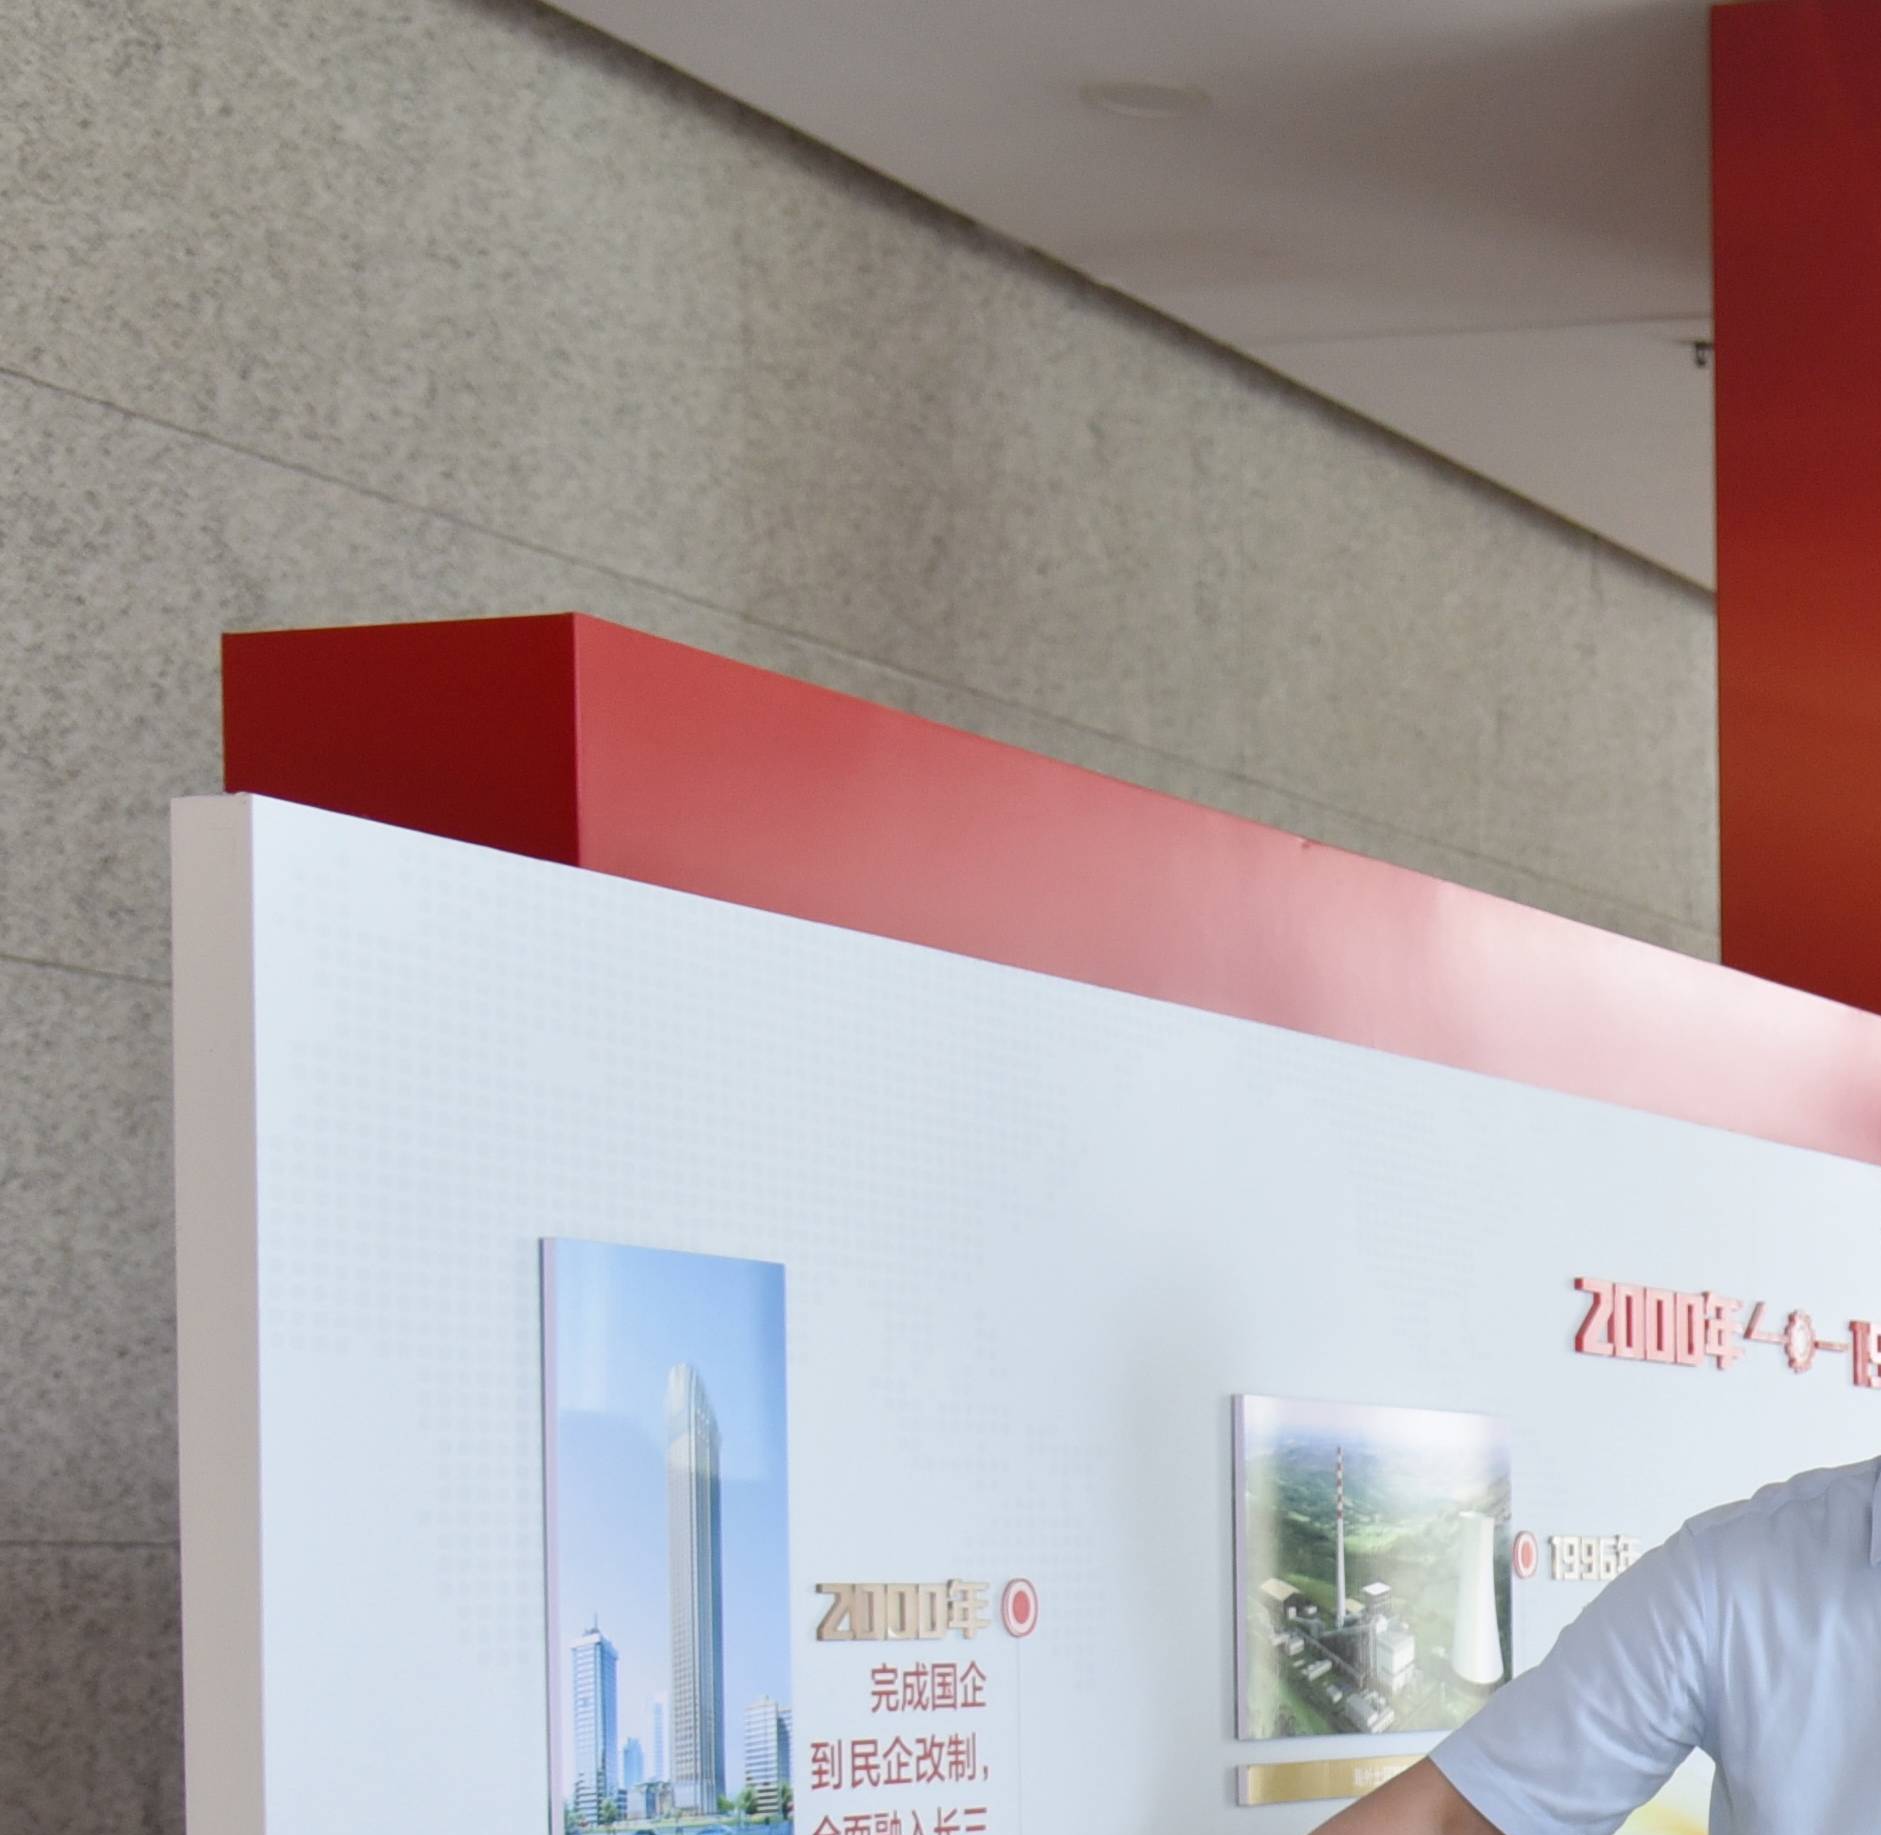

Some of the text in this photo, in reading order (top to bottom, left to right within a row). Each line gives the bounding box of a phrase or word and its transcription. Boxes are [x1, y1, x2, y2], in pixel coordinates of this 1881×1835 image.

[1573, 1276, 1745, 1371] 2000年
[813, 1578, 991, 1642] 2000年
[869, 1659, 988, 1714] 完成国企
[810, 1731, 991, 1791] 到民企改制，
